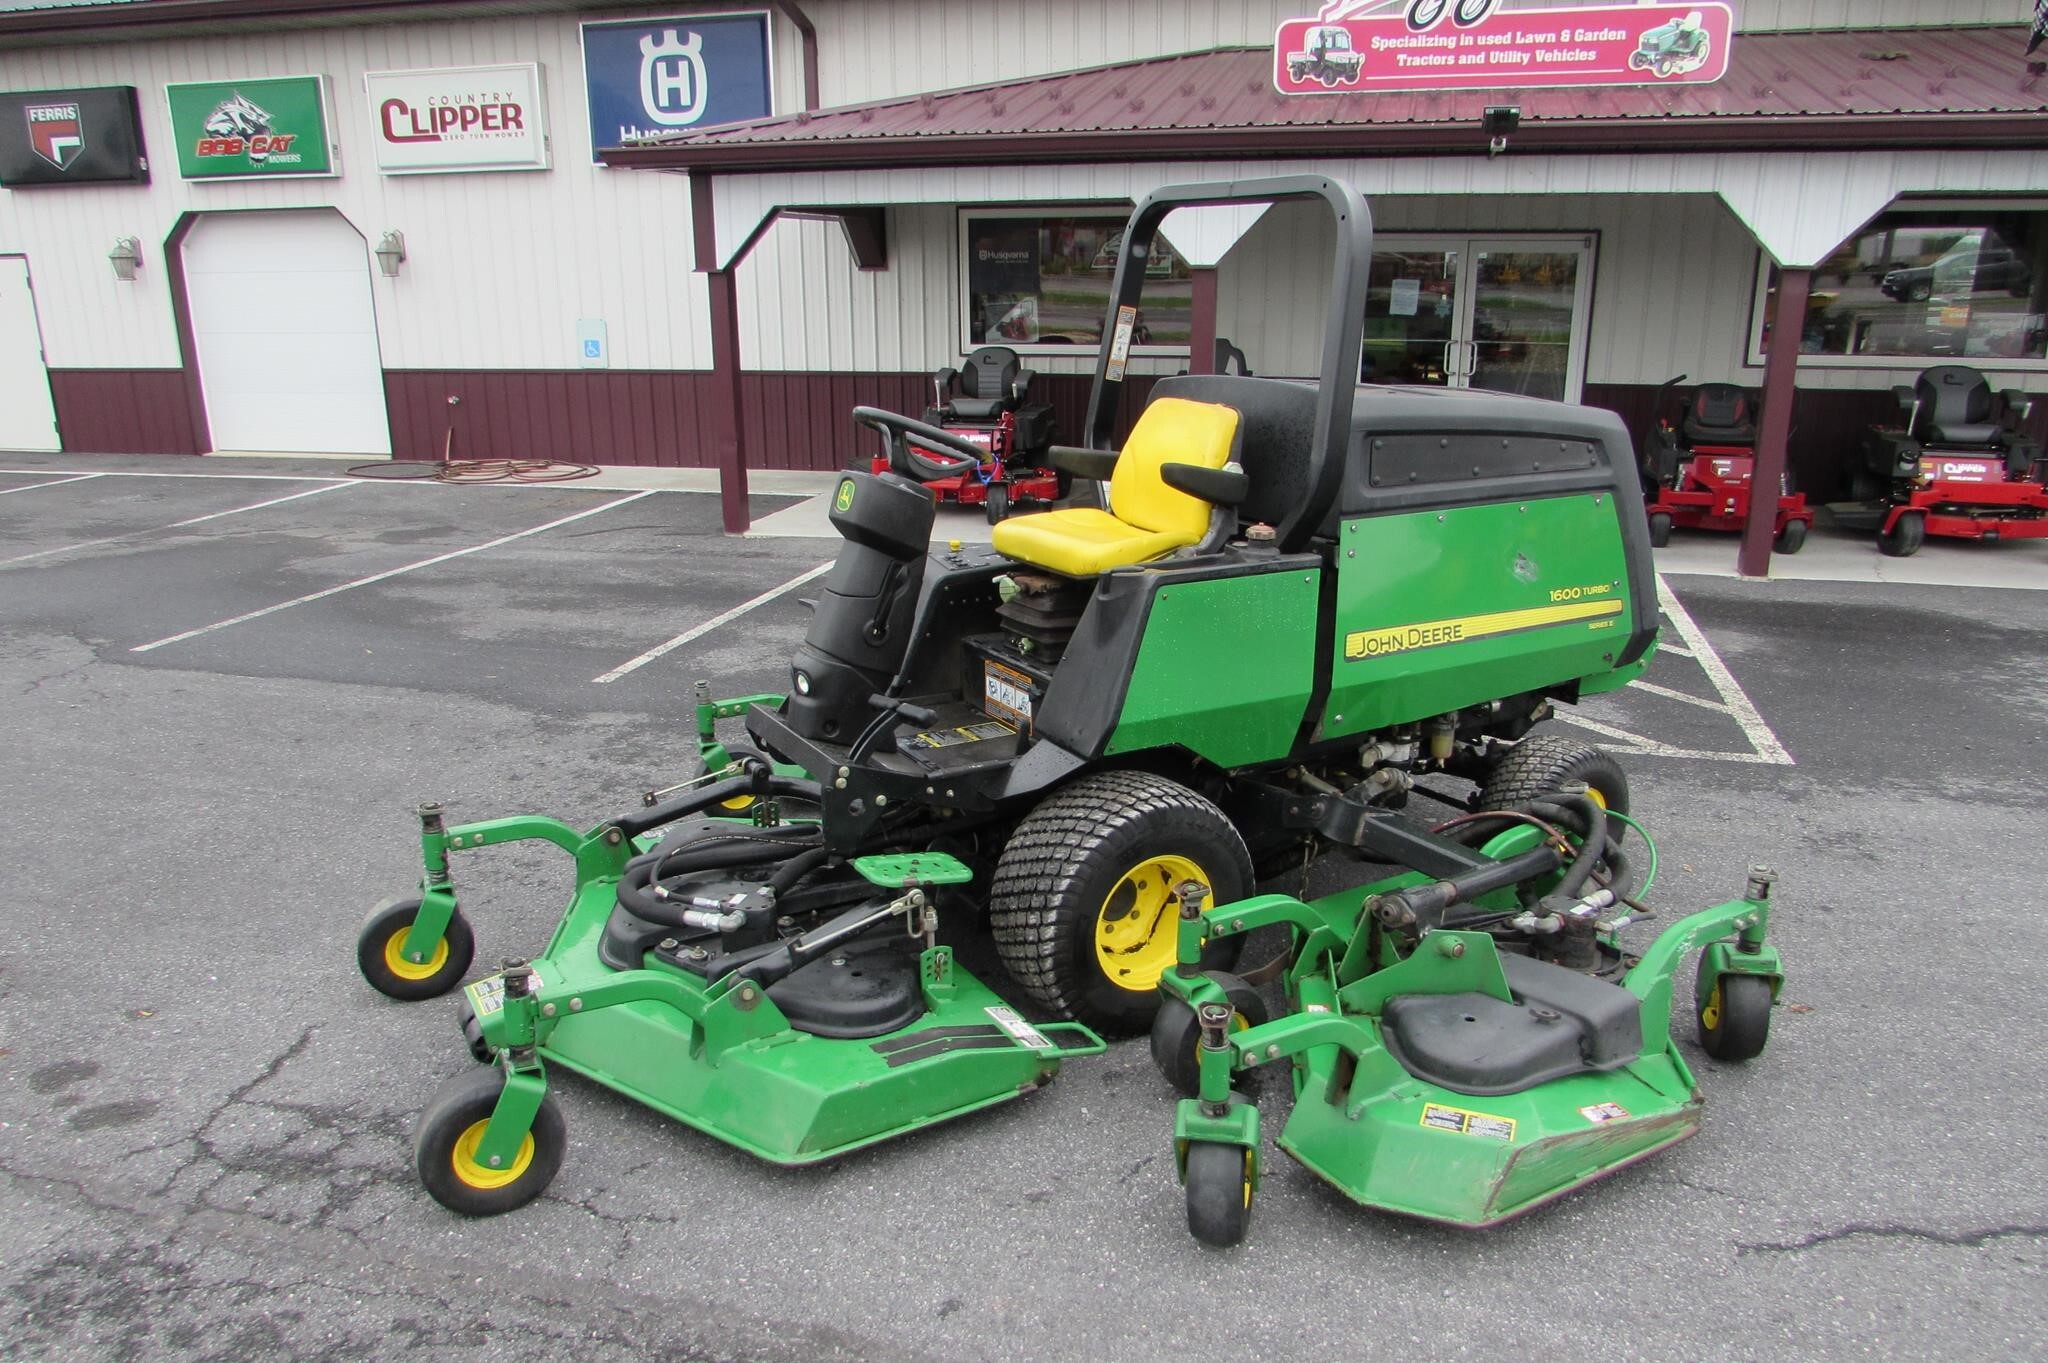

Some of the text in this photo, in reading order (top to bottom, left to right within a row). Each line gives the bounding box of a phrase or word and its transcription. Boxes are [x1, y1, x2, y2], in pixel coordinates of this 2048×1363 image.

[1371, 28, 1626, 51] Specializing in used Lawn & Garden
[1397, 48, 1597, 67] Tractors and Utility Vehicles
[428, 92, 513, 106] COUNTRY
[29, 106, 77, 122] FERRIS
[268, 153, 302, 164] MOWERS
[1550, 585, 1609, 603] 1600 TURBO
